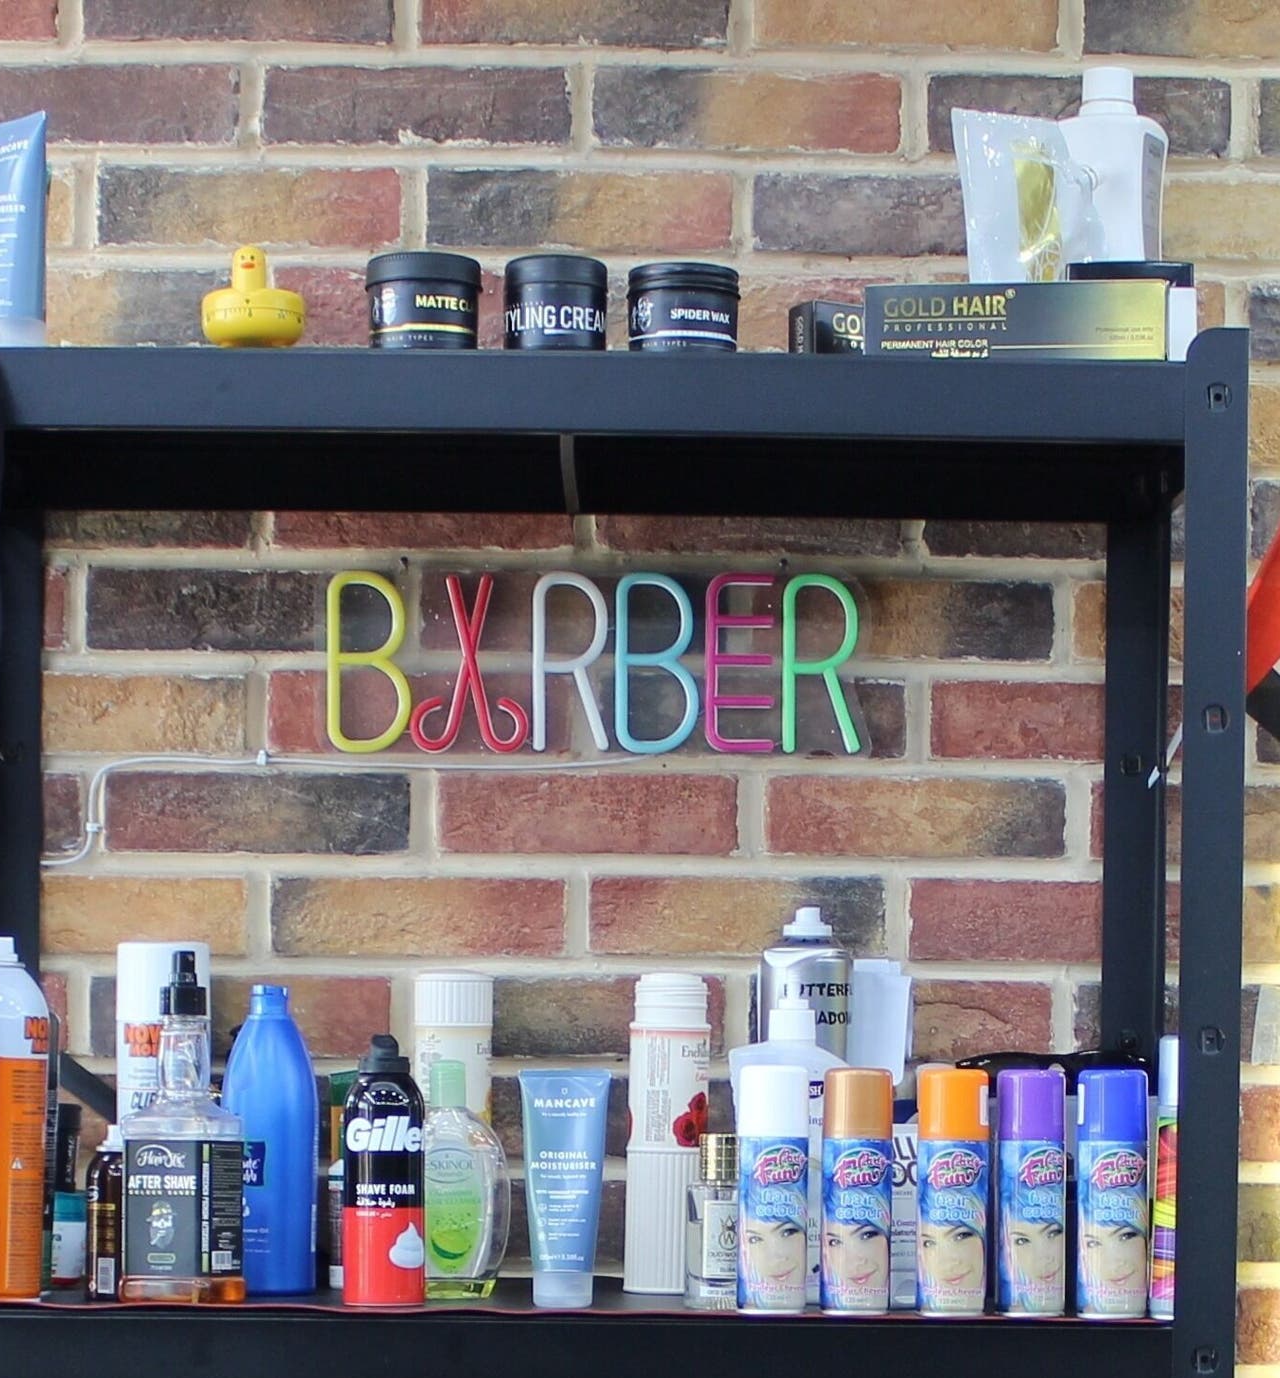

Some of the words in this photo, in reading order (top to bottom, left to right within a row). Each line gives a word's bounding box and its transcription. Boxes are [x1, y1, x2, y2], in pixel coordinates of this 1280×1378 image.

[415, 294, 457, 311] MATTE
[883, 296, 946, 317] GOLD
[952, 294, 1007, 316] HAIR
[670, 307, 711, 322] SPIDER
[711, 308, 731, 325] WAX
[883, 322, 1007, 332] PROFESSIONAL
[880, 340, 934, 350] PERMANENT
[935, 339, 957, 349] HAIR
[957, 339, 988, 349] COLOR
[533, 1098, 596, 1108] MANCAVE
[346, 1115, 424, 1152] Gille
[539, 1150, 589, 1160] ORIGINAL
[530, 1161, 597, 1171] MOISTURISER
[754, 1157, 800, 1188] Fun
[833, 1159, 881, 1189] Fun
[1021, 1158, 1062, 1189] Fun
[127, 1174, 162, 1190] AFTER
[163, 1174, 198, 1190] SHAVE
[928, 1159, 977, 1191] Fun
[1091, 1159, 1141, 1192] Fun
[356, 1183, 386, 1195] SHAVE
[389, 1183, 416, 1195] FOAM
[755, 1204, 803, 1218] colour
[835, 1206, 883, 1220] colour
[929, 1206, 977, 1221] colour
